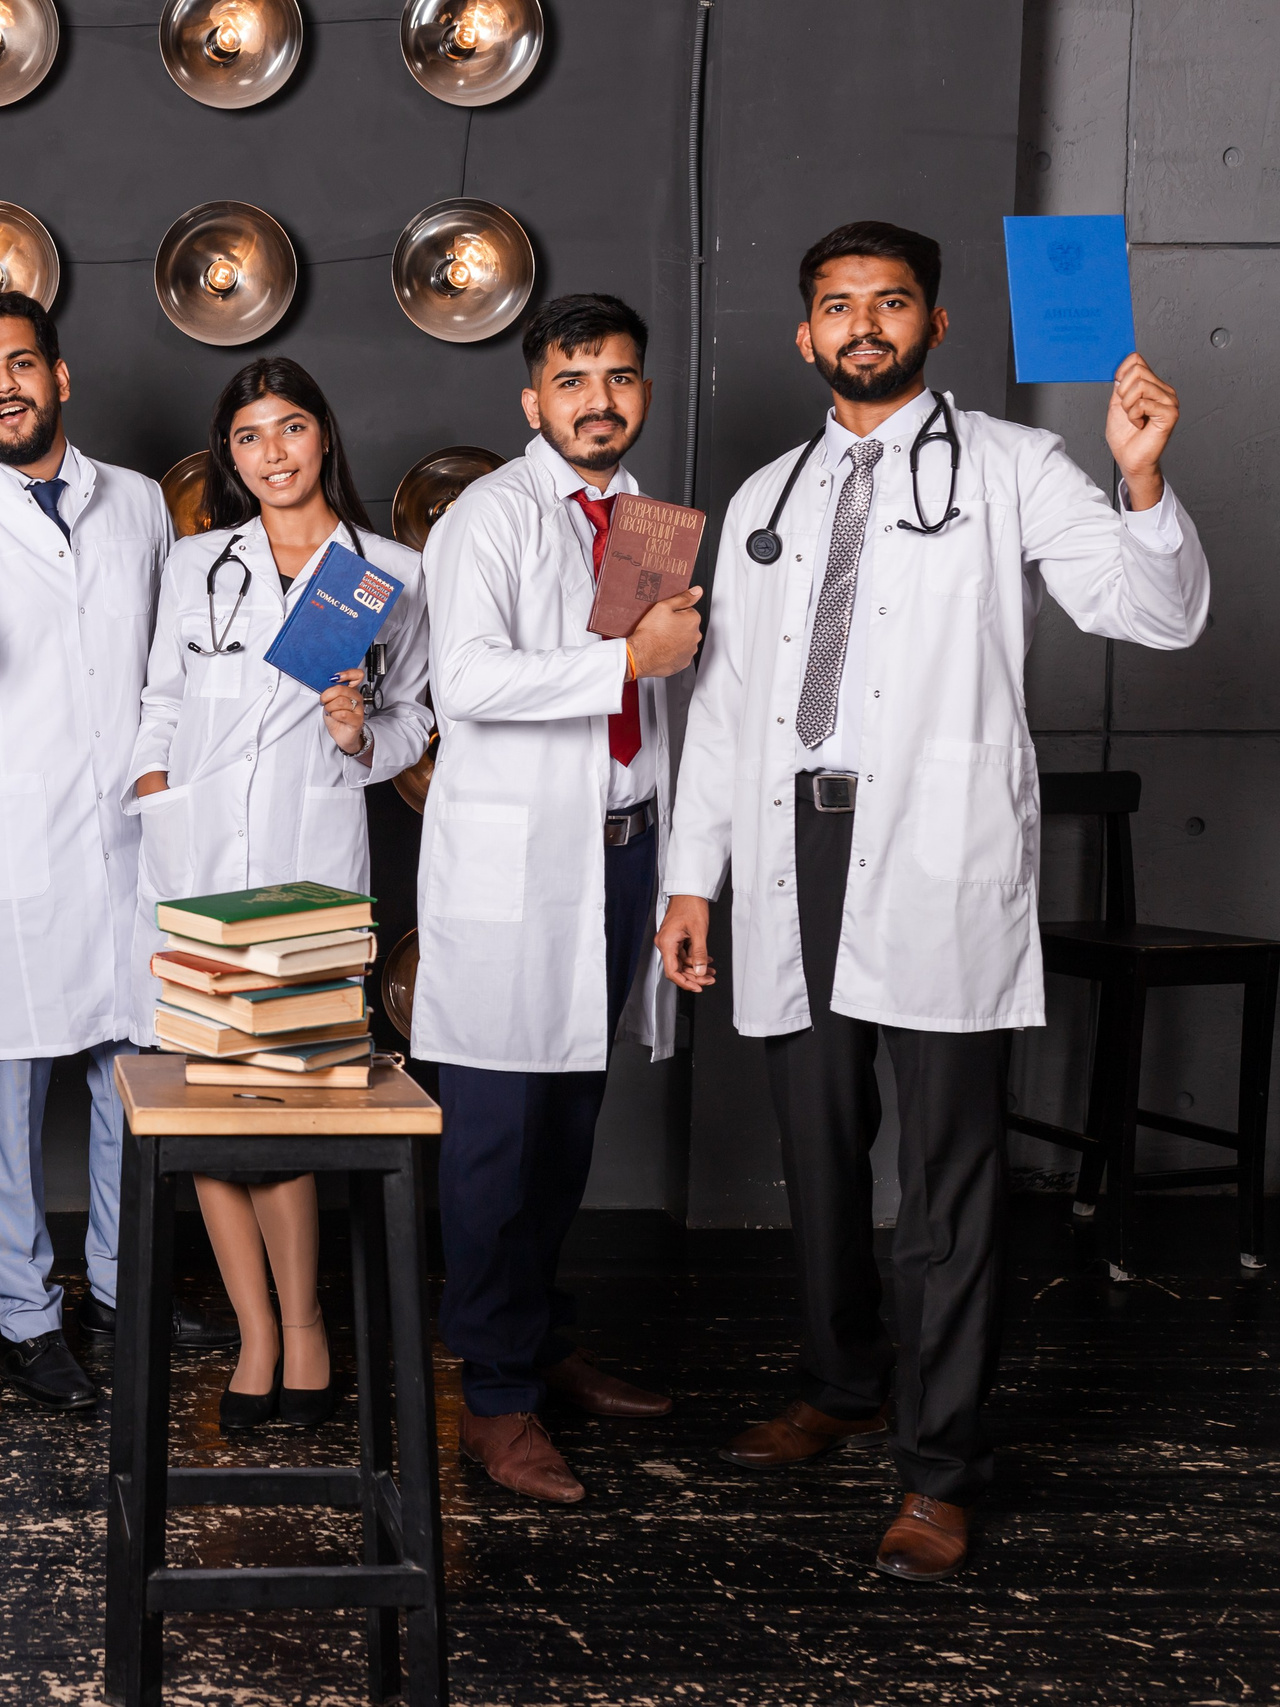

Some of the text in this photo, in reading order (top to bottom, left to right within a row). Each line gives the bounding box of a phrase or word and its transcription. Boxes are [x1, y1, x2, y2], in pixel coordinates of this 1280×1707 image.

[646, 537, 672, 556] СКАЯ
[316, 588, 359, 618] ТОМАС ВУЛФ
[353, 588, 385, 614] США
